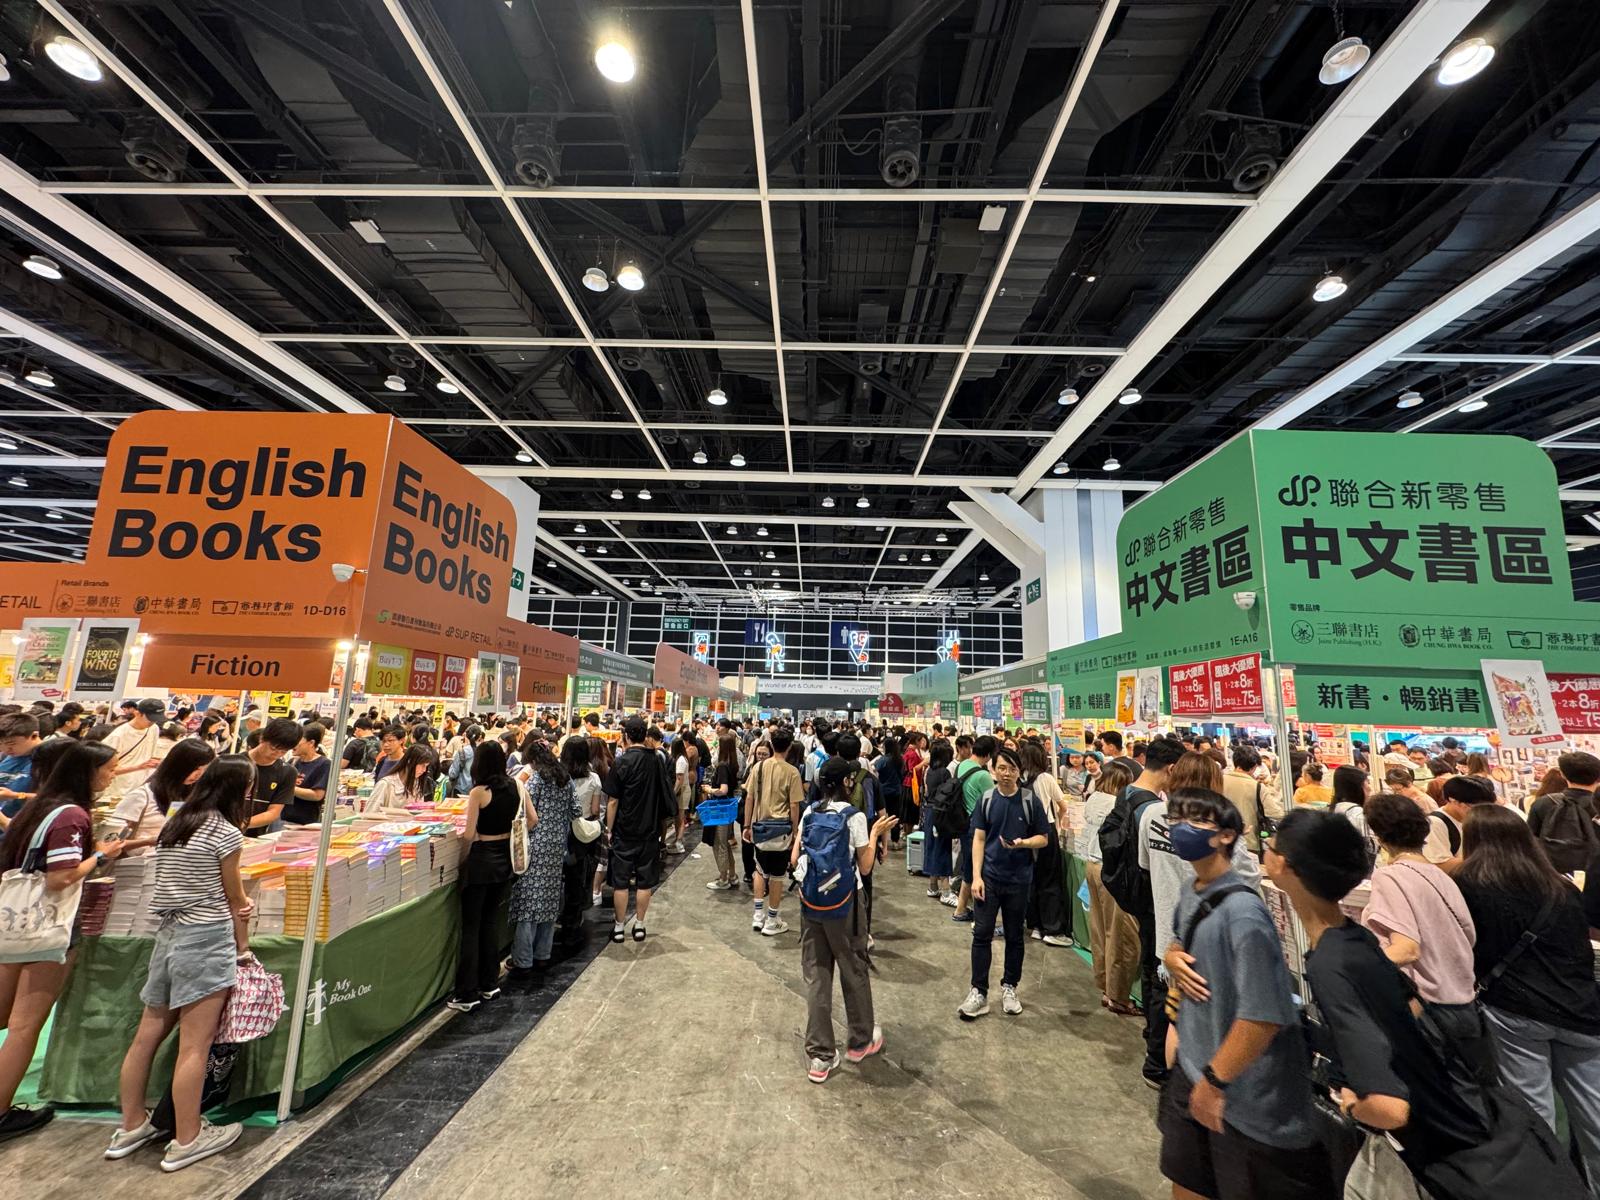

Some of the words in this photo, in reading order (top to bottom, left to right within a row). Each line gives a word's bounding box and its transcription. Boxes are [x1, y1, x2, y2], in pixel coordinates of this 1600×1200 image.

[120, 446, 367, 511] English
[1327, 479, 1506, 513] 聯合新零售
[393, 461, 510, 562] English
[107, 509, 322, 563] Books
[1143, 497, 1225, 558] 聯合新零售
[1281, 518, 1553, 585] 中文書區
[383, 522, 491, 605] Books
[1126, 525, 1253, 618] 中文書區
[303, 605, 347, 616] 1D-D16
[454, 628, 469, 640] SUP
[1230, 632, 1258, 646] 1E-A16
[1317, 622, 1379, 638] 三聯書店
[1422, 625, 1492, 643] 中華書局
[86, 649, 120, 659] FOURTH
[380, 655, 392, 665] Buy
[84, 658, 118, 671] WING
[191, 654, 281, 677] Fiction
[533, 681, 556, 696] Fiction
[329, 988, 356, 1005] Book
[358, 984, 372, 996] One
[332, 978, 351, 992] My
